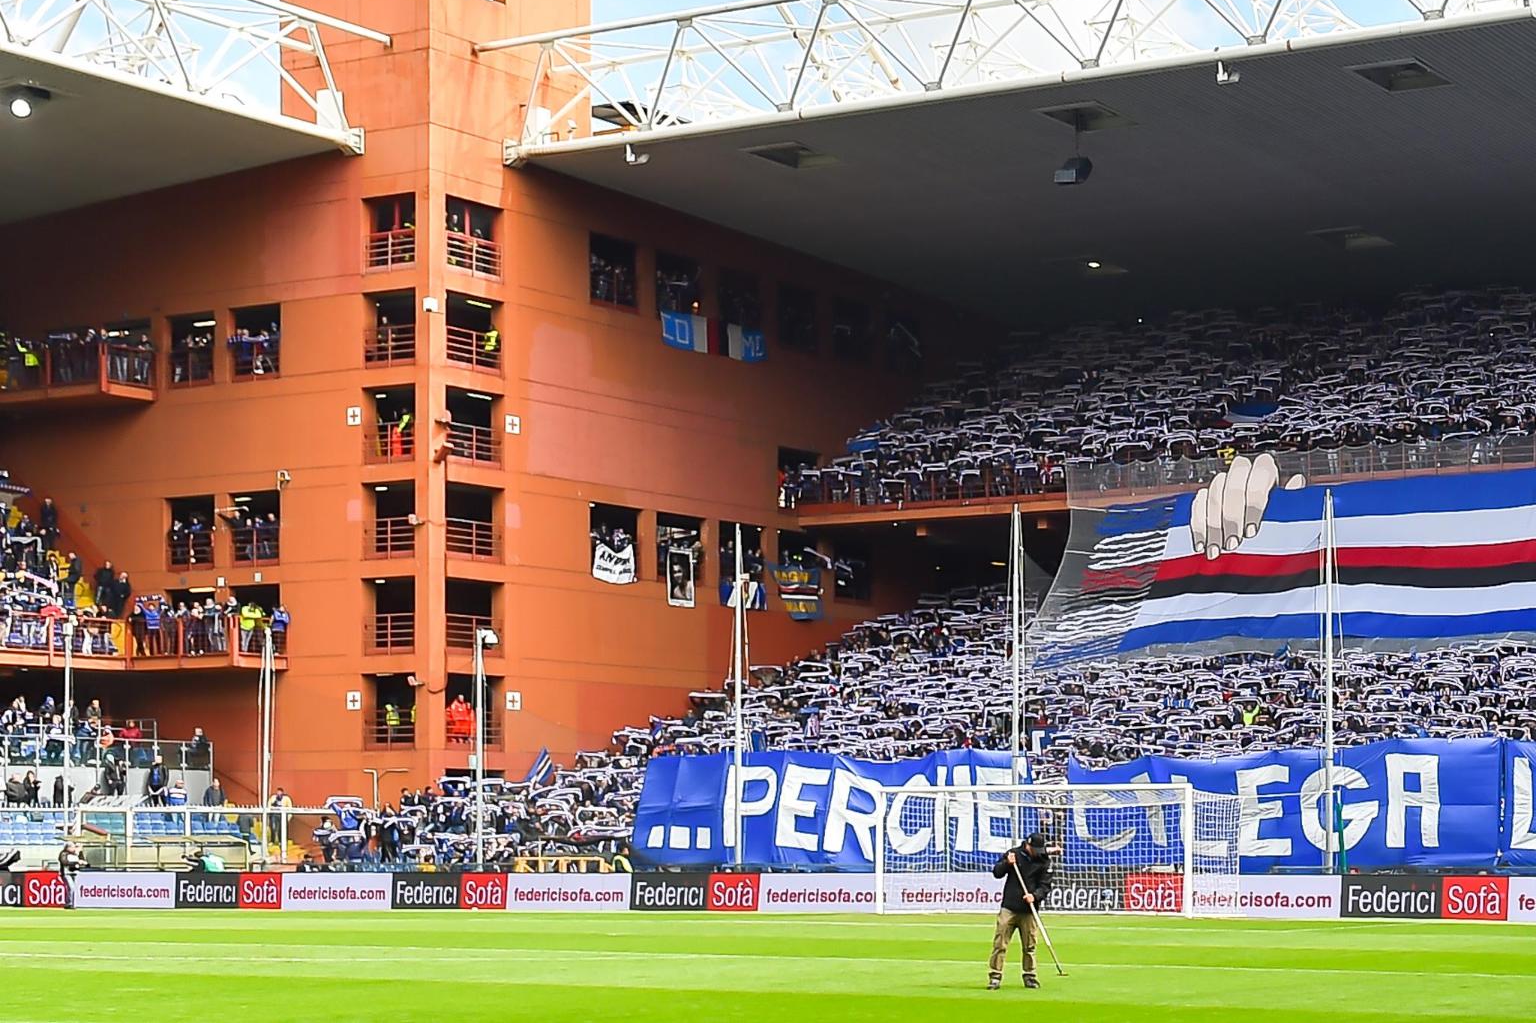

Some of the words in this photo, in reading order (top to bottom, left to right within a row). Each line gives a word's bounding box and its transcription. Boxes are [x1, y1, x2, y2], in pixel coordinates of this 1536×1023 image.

[80, 884, 170, 899] federicisofa.com
[179, 879, 236, 903] Federici
[243, 877, 277, 904] Sofà
[288, 885, 386, 900] federicisofa.com
[396, 880, 457, 905] Federici
[465, 878, 502, 905] Sofà
[514, 885, 624, 903] federicisofa.com
[635, 881, 704, 906] Federici
[712, 879, 753, 906] Sofà
[901, 887, 1002, 903] federicisofa.c
[1040, 882, 1118, 909] ederii
[1130, 881, 1176, 910] Sofà
[1348, 882, 1435, 914] Federici
[1447, 882, 1500, 915] Sofà
